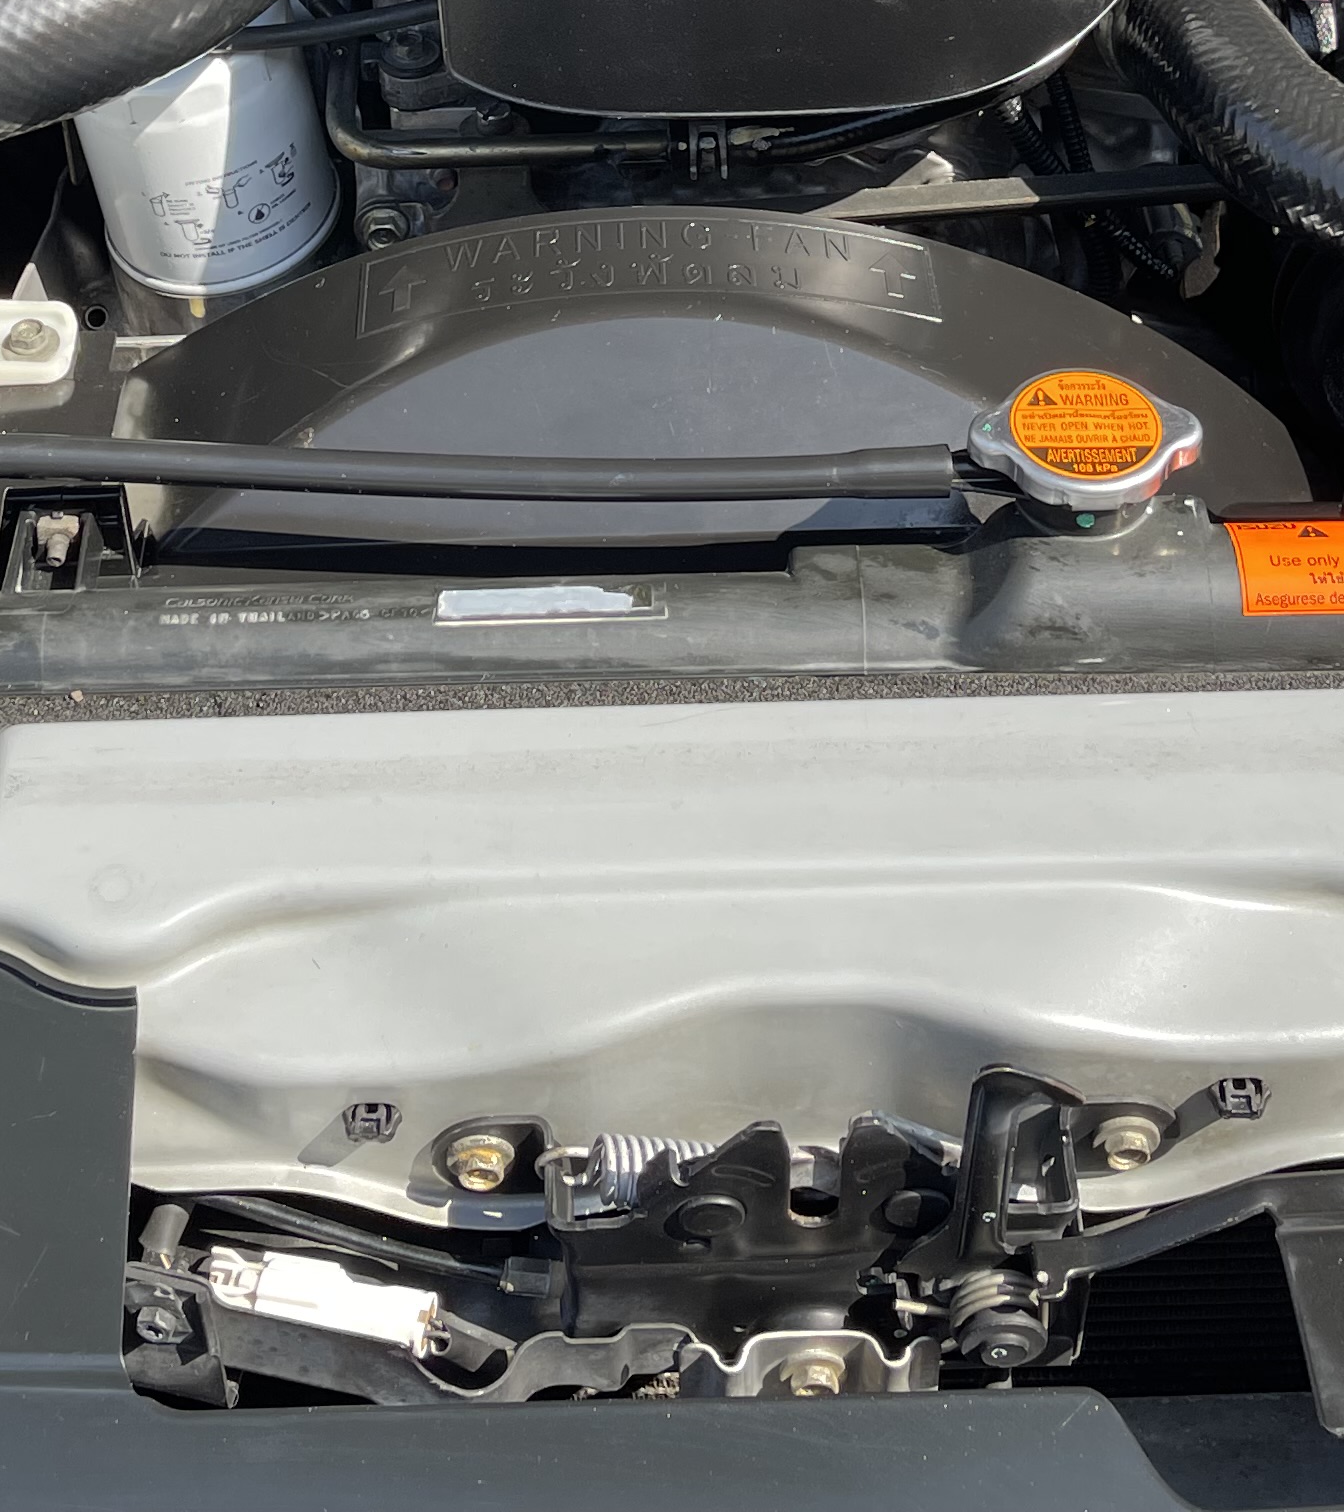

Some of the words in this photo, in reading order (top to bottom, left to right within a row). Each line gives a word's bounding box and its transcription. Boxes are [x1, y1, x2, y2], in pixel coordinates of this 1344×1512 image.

[443, 221, 713, 271] WARNING
[1059, 393, 1129, 407] WARNING
[1022, 422, 1056, 432] NEVER
[1061, 421, 1088, 431] OPEN
[1093, 422, 1124, 432] WHEN
[1039, 434, 1073, 444] JAMAIS
[1075, 434, 1109, 444] OUVRIR
[1047, 447, 1138, 463] AVERTISSEMENT
[1096, 463, 1119, 473] kPa
[1269, 554, 1302, 567] Use
[1307, 553, 1340, 569] only
[1255, 592, 1325, 608] Asegurese
[159, 612, 199, 625] MADE
[237, 610, 315, 624] THAILAND
